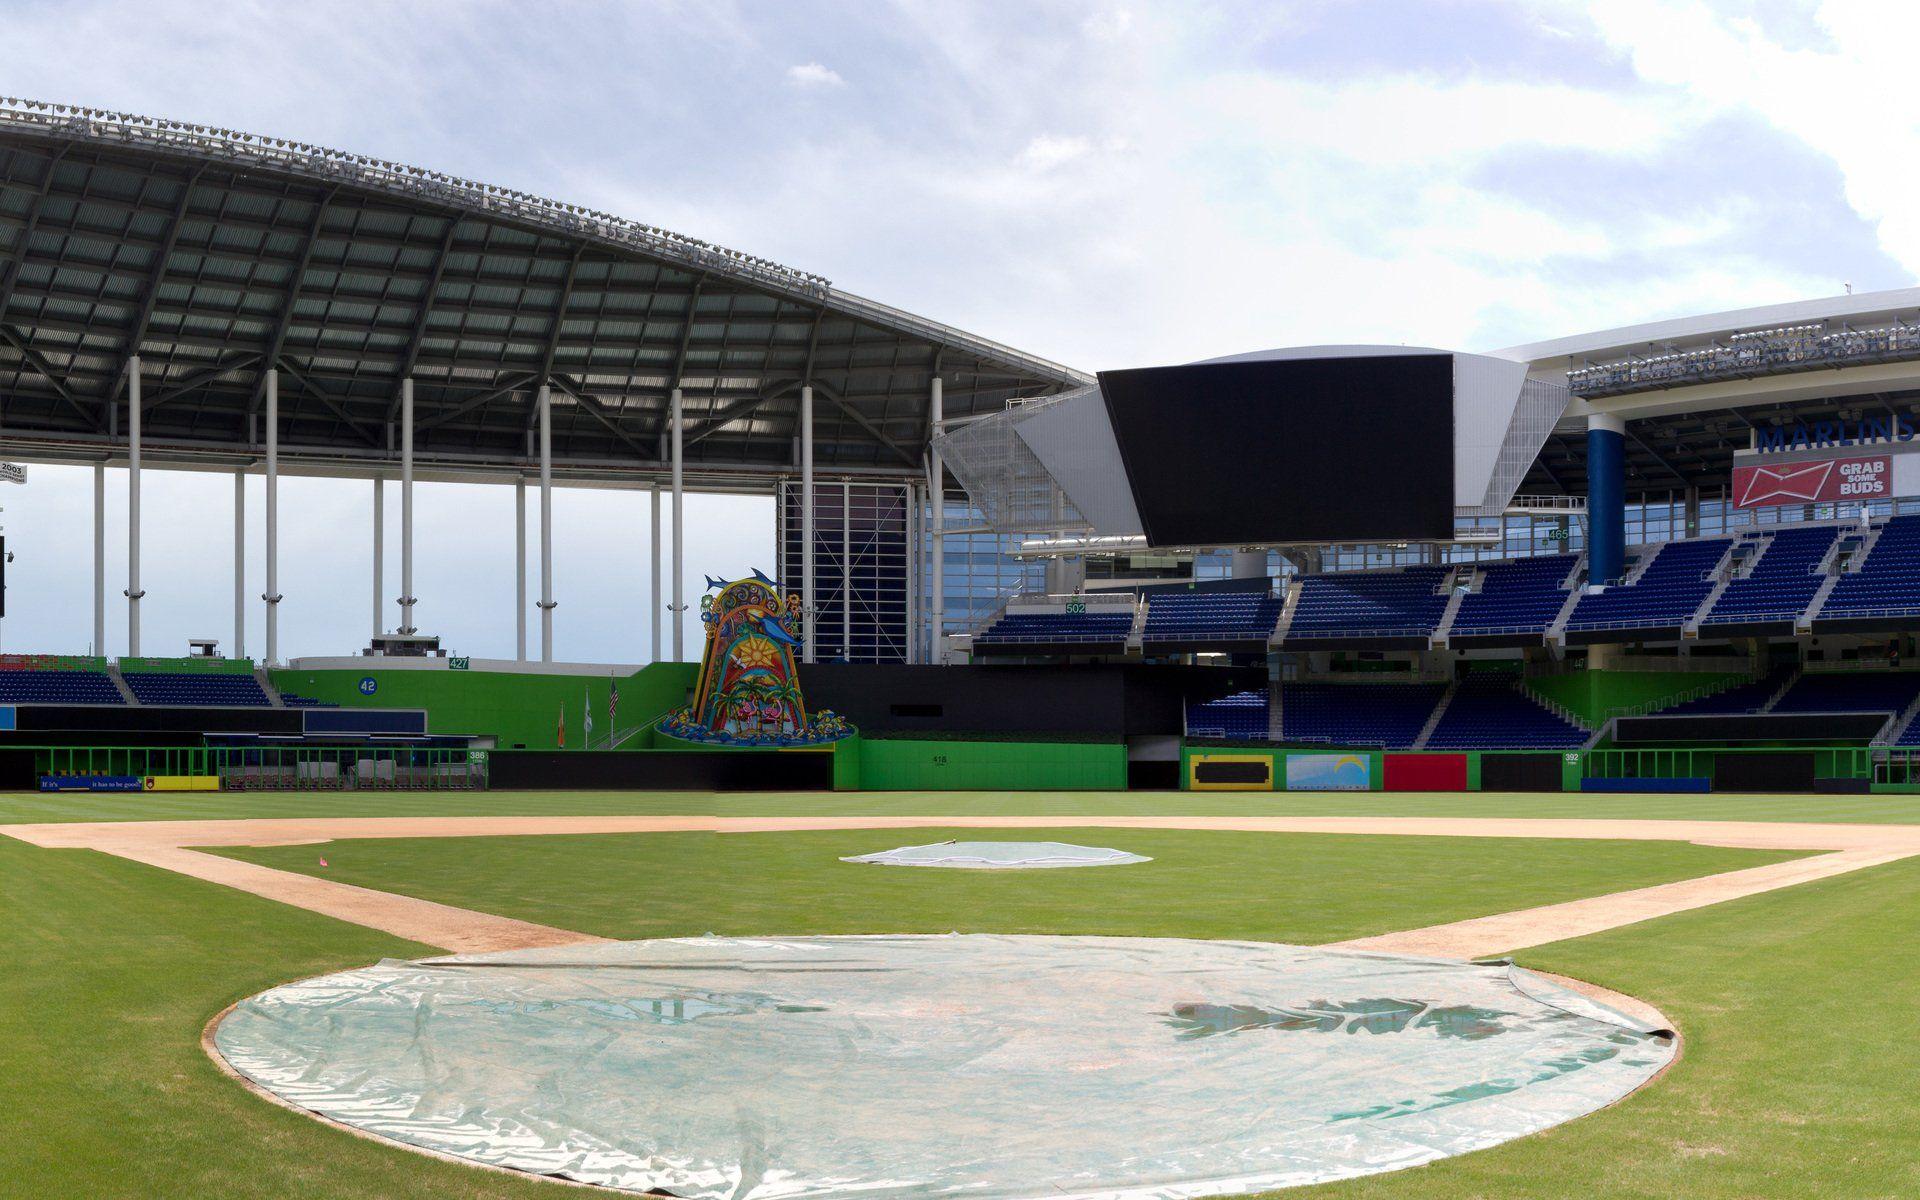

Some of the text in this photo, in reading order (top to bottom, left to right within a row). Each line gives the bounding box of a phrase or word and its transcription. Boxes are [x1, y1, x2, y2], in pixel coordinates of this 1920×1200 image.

[1758, 413, 1914, 453] MARLINS
[2, 463, 22, 475] 2003
[1839, 461, 1885, 475] GRAB
[1847, 473, 1877, 483] SOME
[1840, 480, 1884, 495] BUDS
[1549, 529, 1569, 540] 465
[1066, 603, 1085, 614] 502
[450, 658, 468, 669] 427
[360, 680, 375, 691] 42
[470, 751, 485, 760] 386
[1565, 753, 1579, 761] 392
